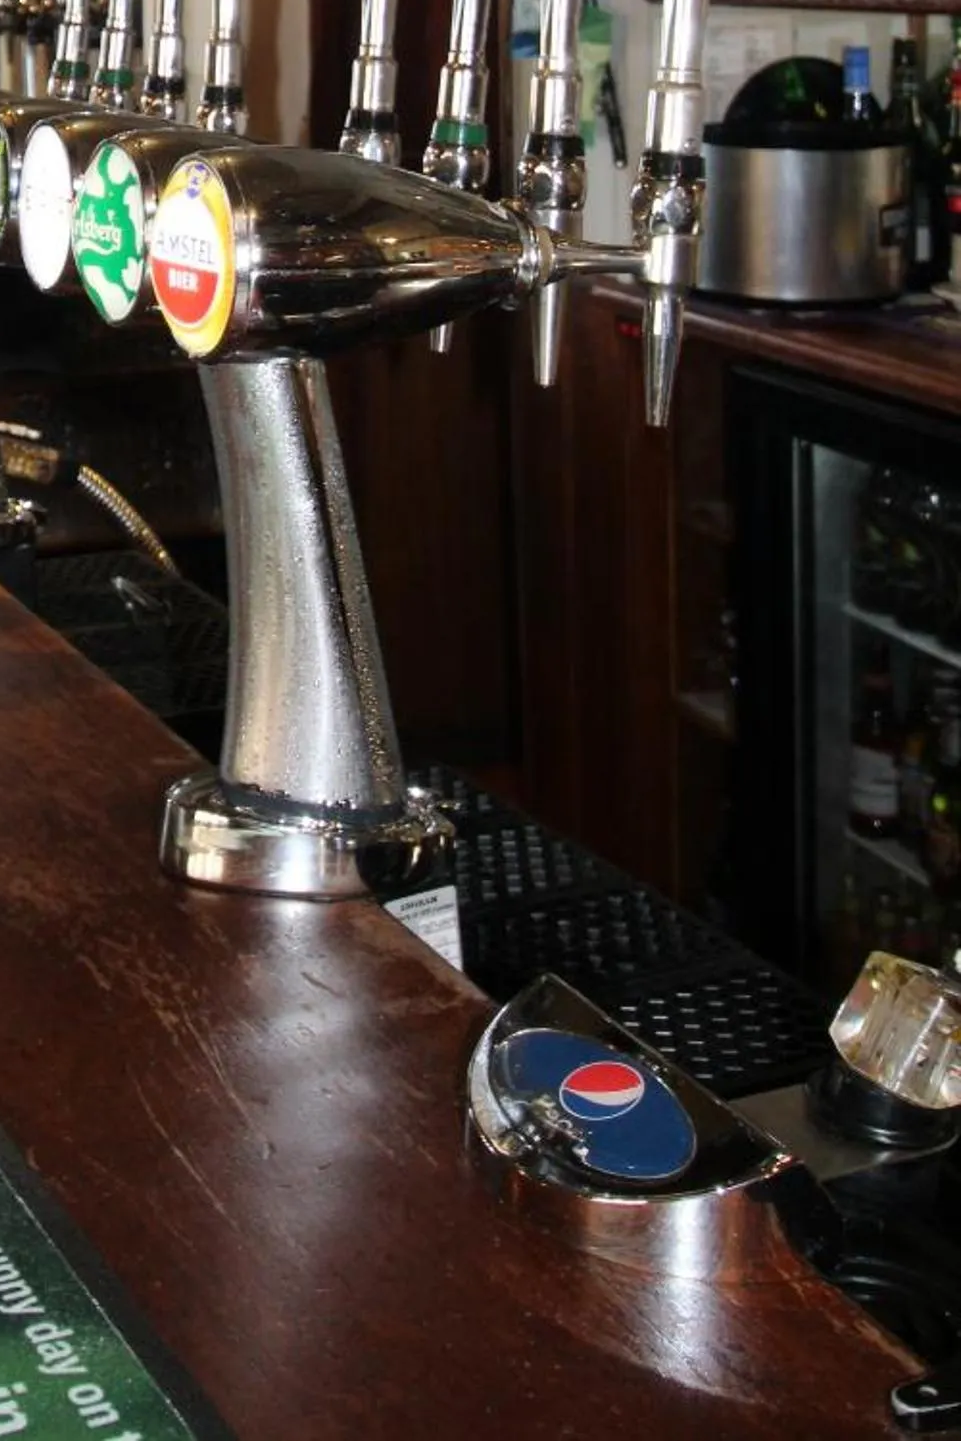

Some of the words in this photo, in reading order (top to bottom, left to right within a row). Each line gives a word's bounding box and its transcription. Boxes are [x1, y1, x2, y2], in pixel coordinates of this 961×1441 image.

[157, 230, 216, 265] AMSTEL
[168, 267, 199, 293] BIER
[24, 1321, 88, 1375] day
[67, 1383, 120, 1429] on
